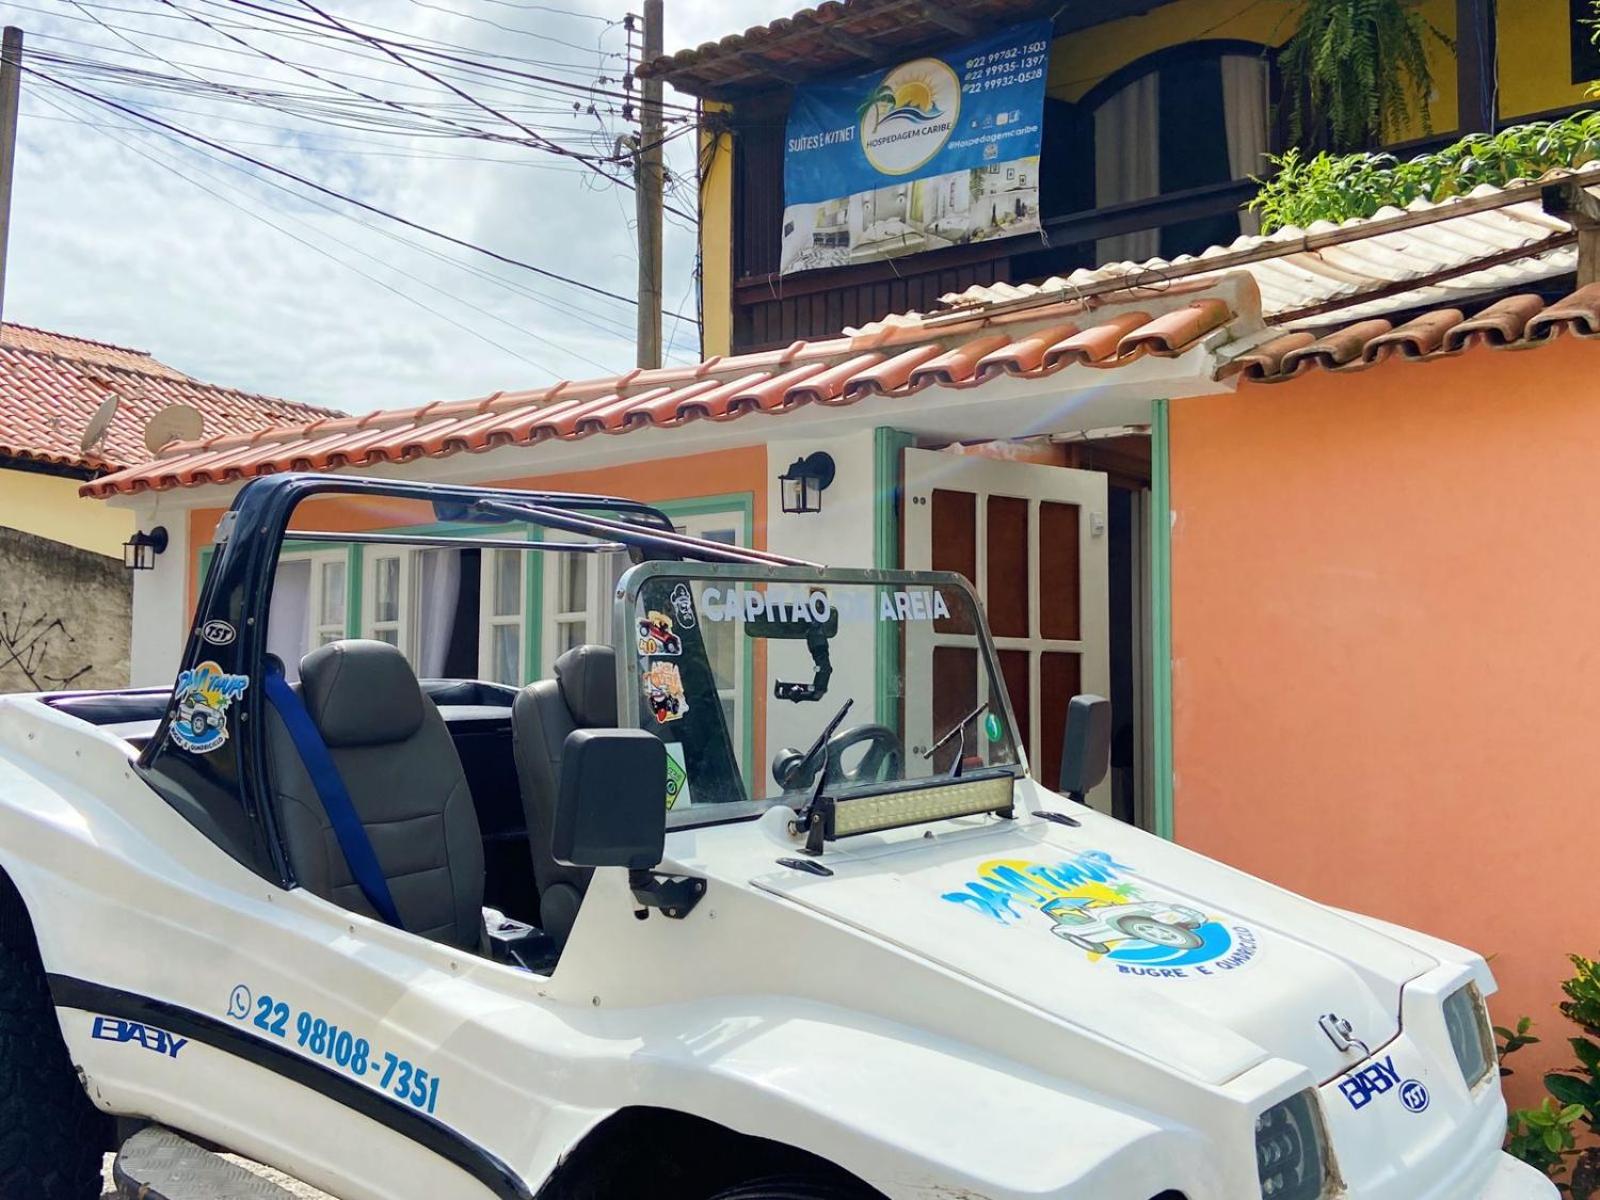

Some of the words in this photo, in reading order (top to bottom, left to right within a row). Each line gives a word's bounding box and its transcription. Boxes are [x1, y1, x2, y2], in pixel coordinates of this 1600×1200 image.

[973, 56, 986, 68] 22
[972, 69, 983, 80] 22
[969, 83, 982, 94] 22
[824, 125, 856, 146] KITNET
[866, 130, 921, 149] HOSPEDAGEM
[921, 122, 952, 136] CARIBE
[880, 590, 951, 621] AREIA
[206, 625, 231, 640] TST
[1116, 963, 1188, 978] BUGRE
[1194, 965, 1214, 975] E
[91, 1016, 188, 1059] BABY
[253, 996, 290, 1038] 22
[296, 1011, 440, 1114] 98108-7351
[1338, 1055, 1402, 1110] BABY
[1404, 1085, 1426, 1108] TST
